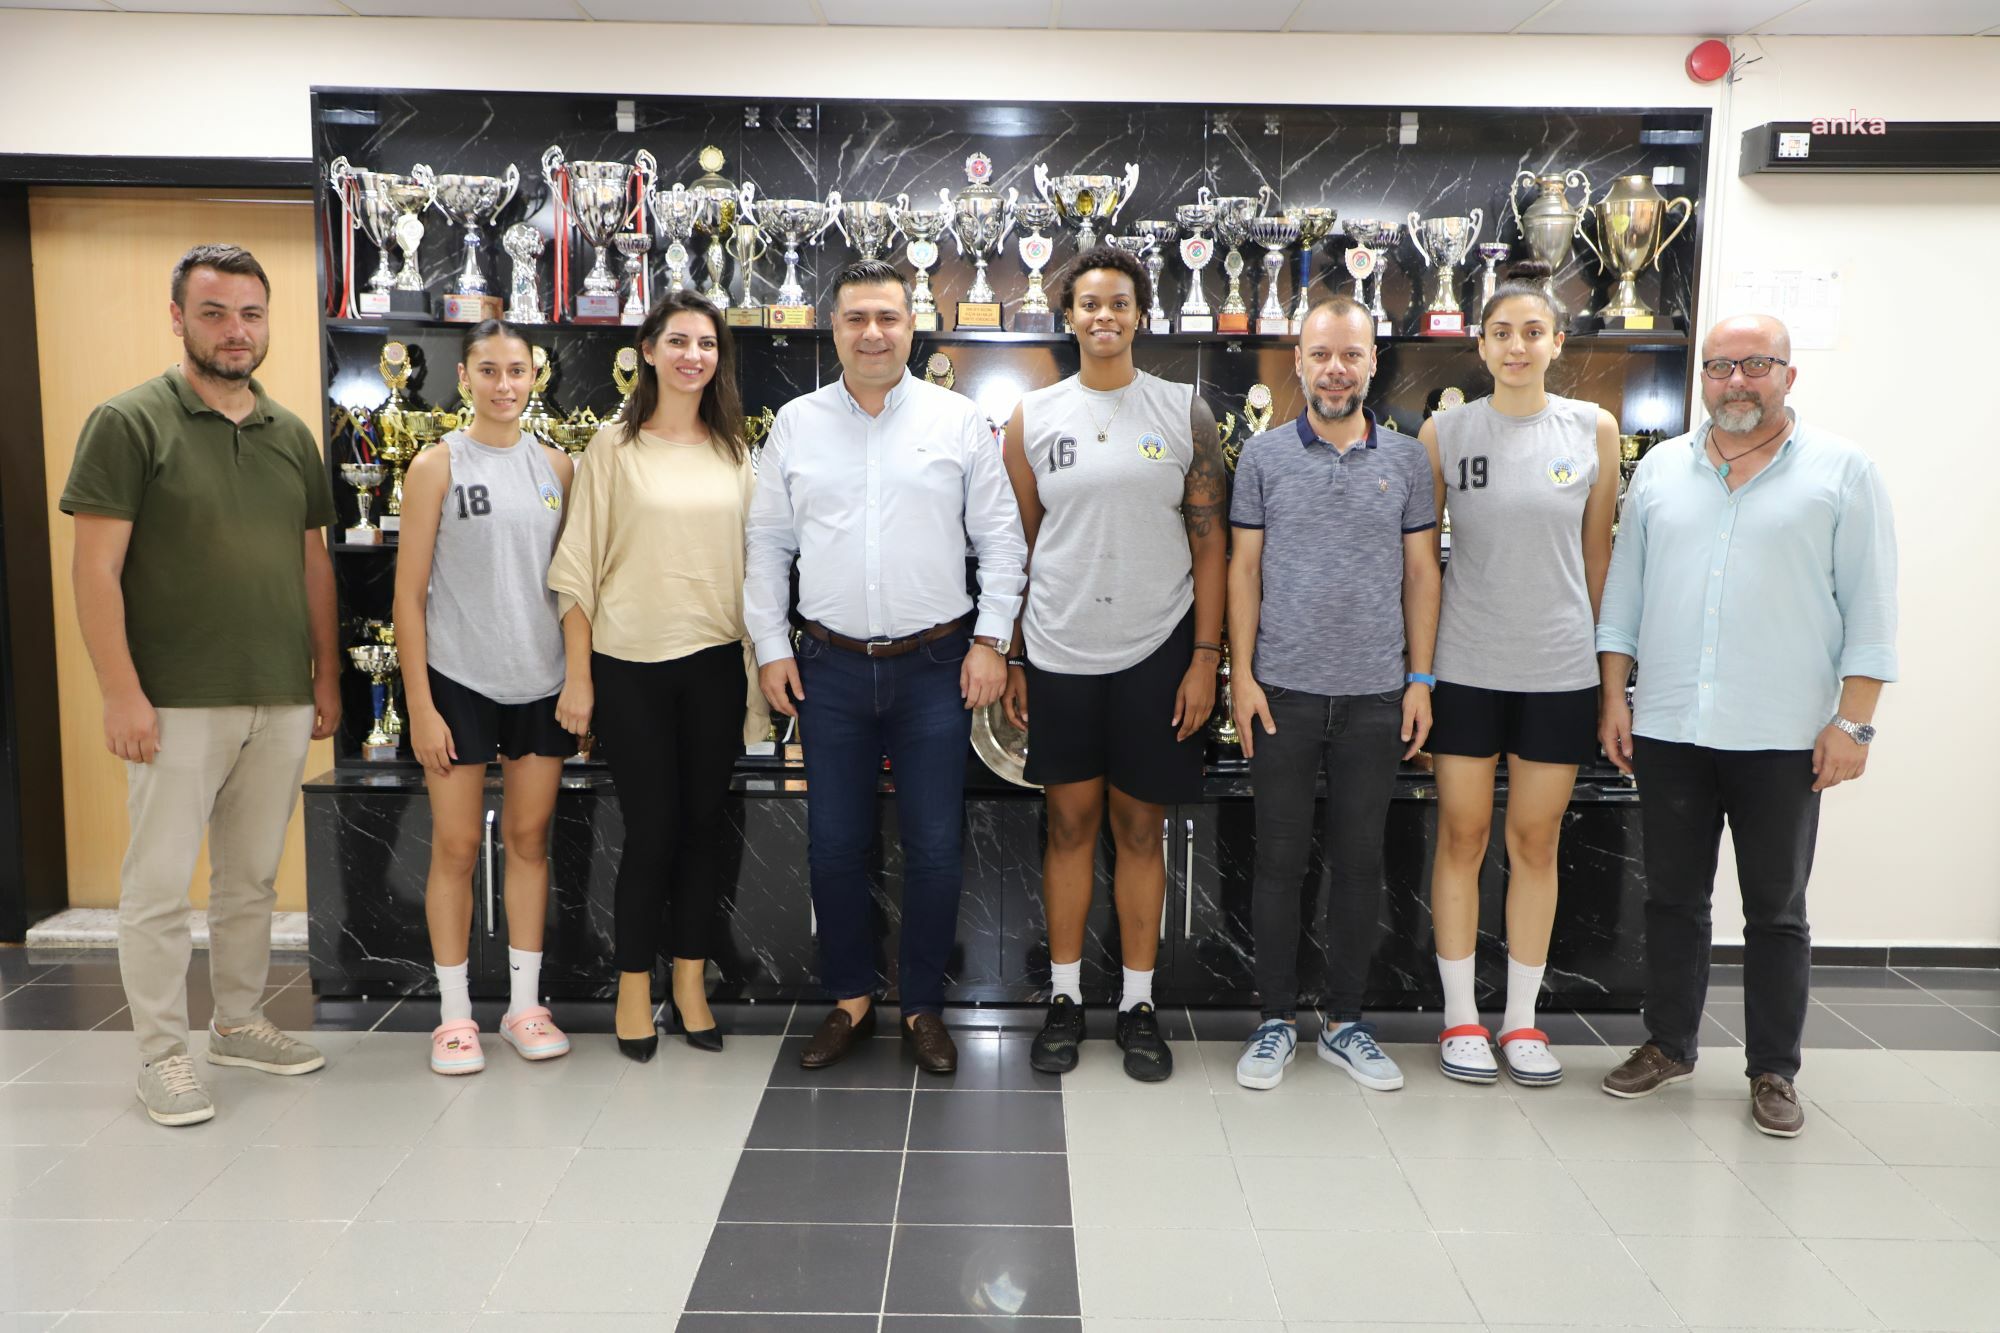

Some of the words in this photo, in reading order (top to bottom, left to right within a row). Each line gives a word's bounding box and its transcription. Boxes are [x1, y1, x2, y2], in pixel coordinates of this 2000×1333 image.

[1049, 437, 1077, 474] 16
[1458, 456, 1489, 491] 19
[454, 484, 493, 521] 18
